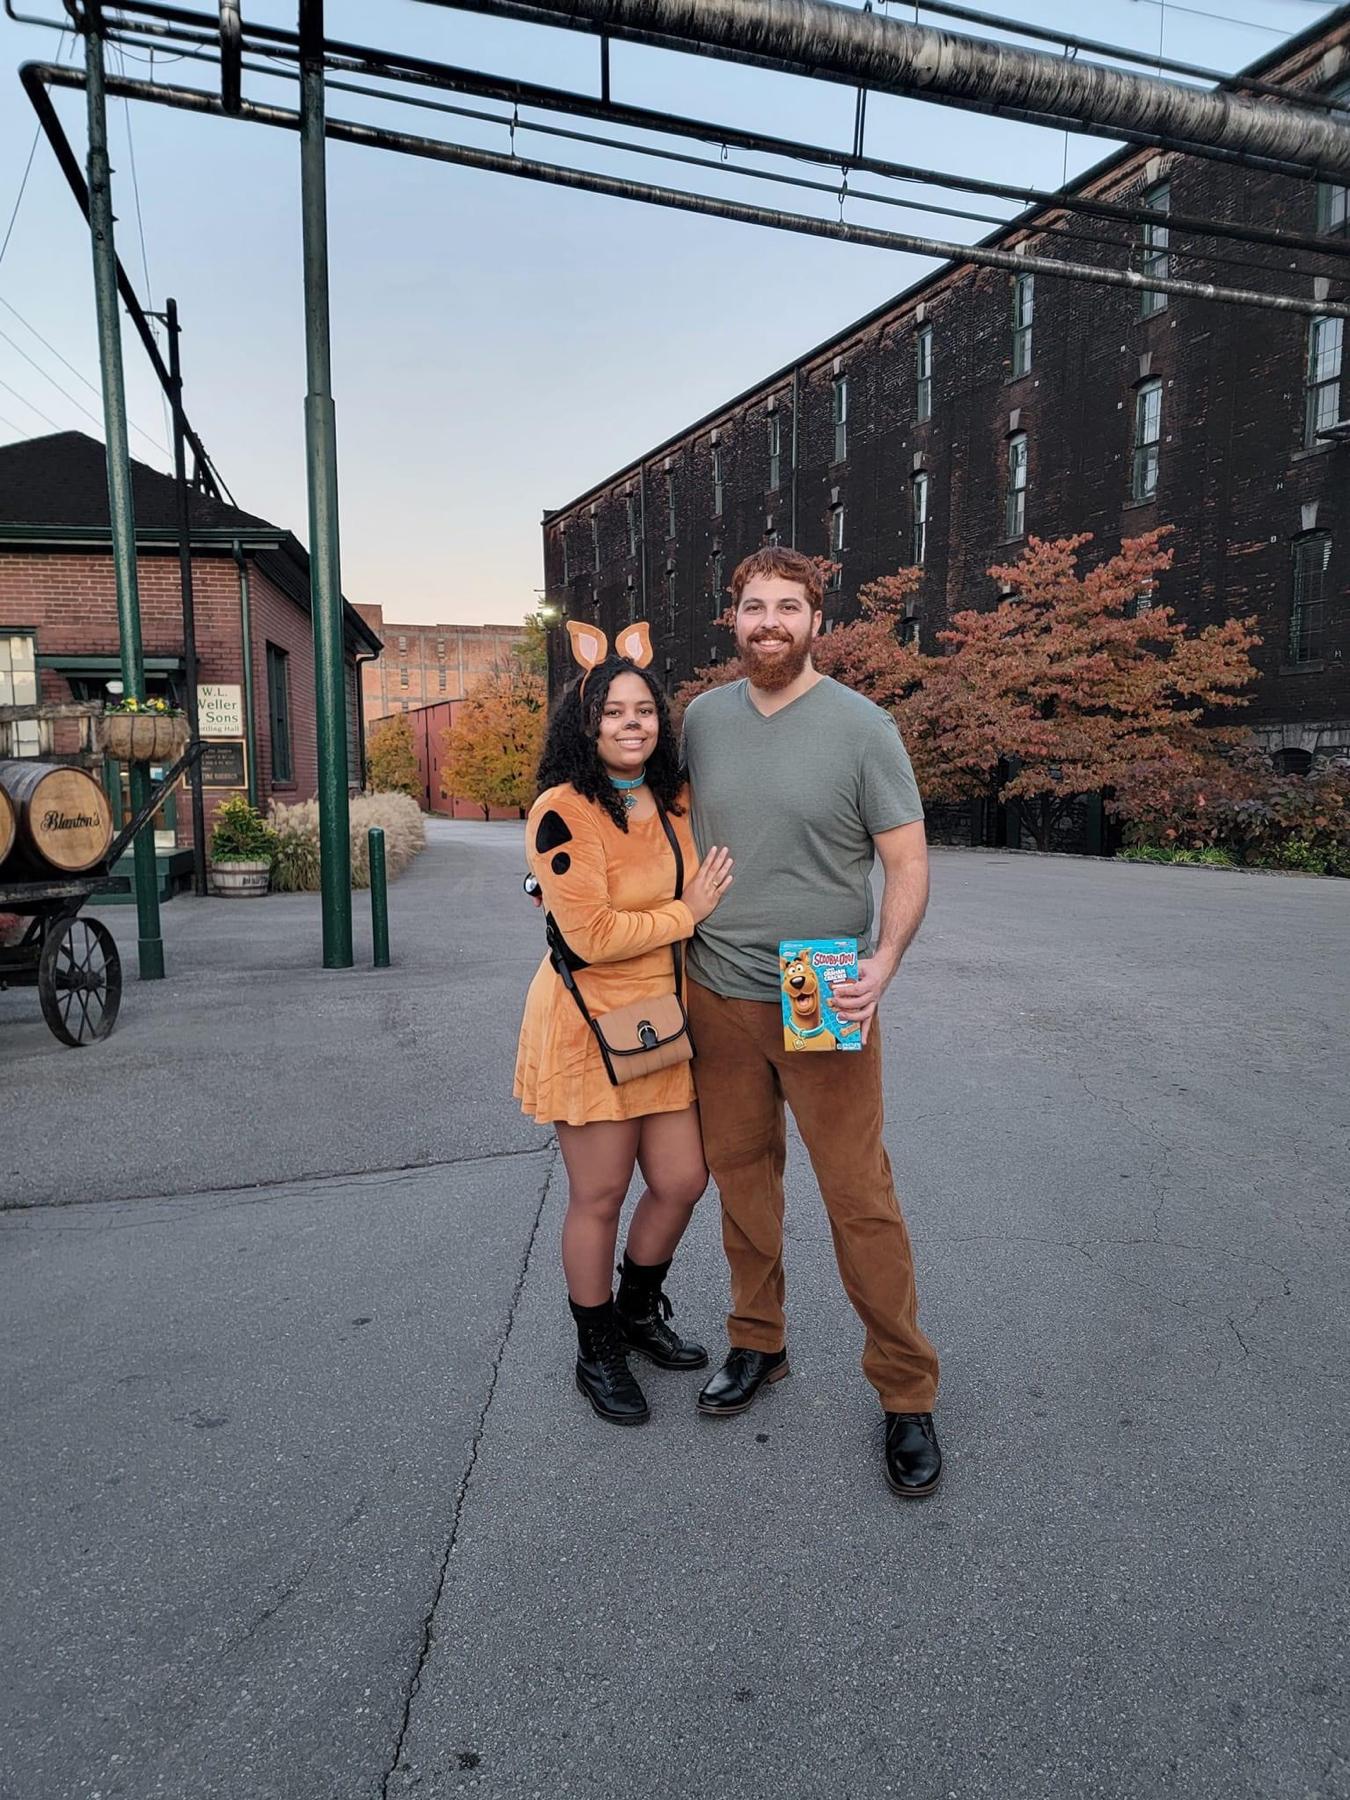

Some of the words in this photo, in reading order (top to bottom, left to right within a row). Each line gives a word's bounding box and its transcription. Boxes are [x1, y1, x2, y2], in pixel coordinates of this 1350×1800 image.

[201, 687, 228, 697] W.L.
[206, 711, 239, 723] Sons
[40, 809, 100, 832] Blanton's
